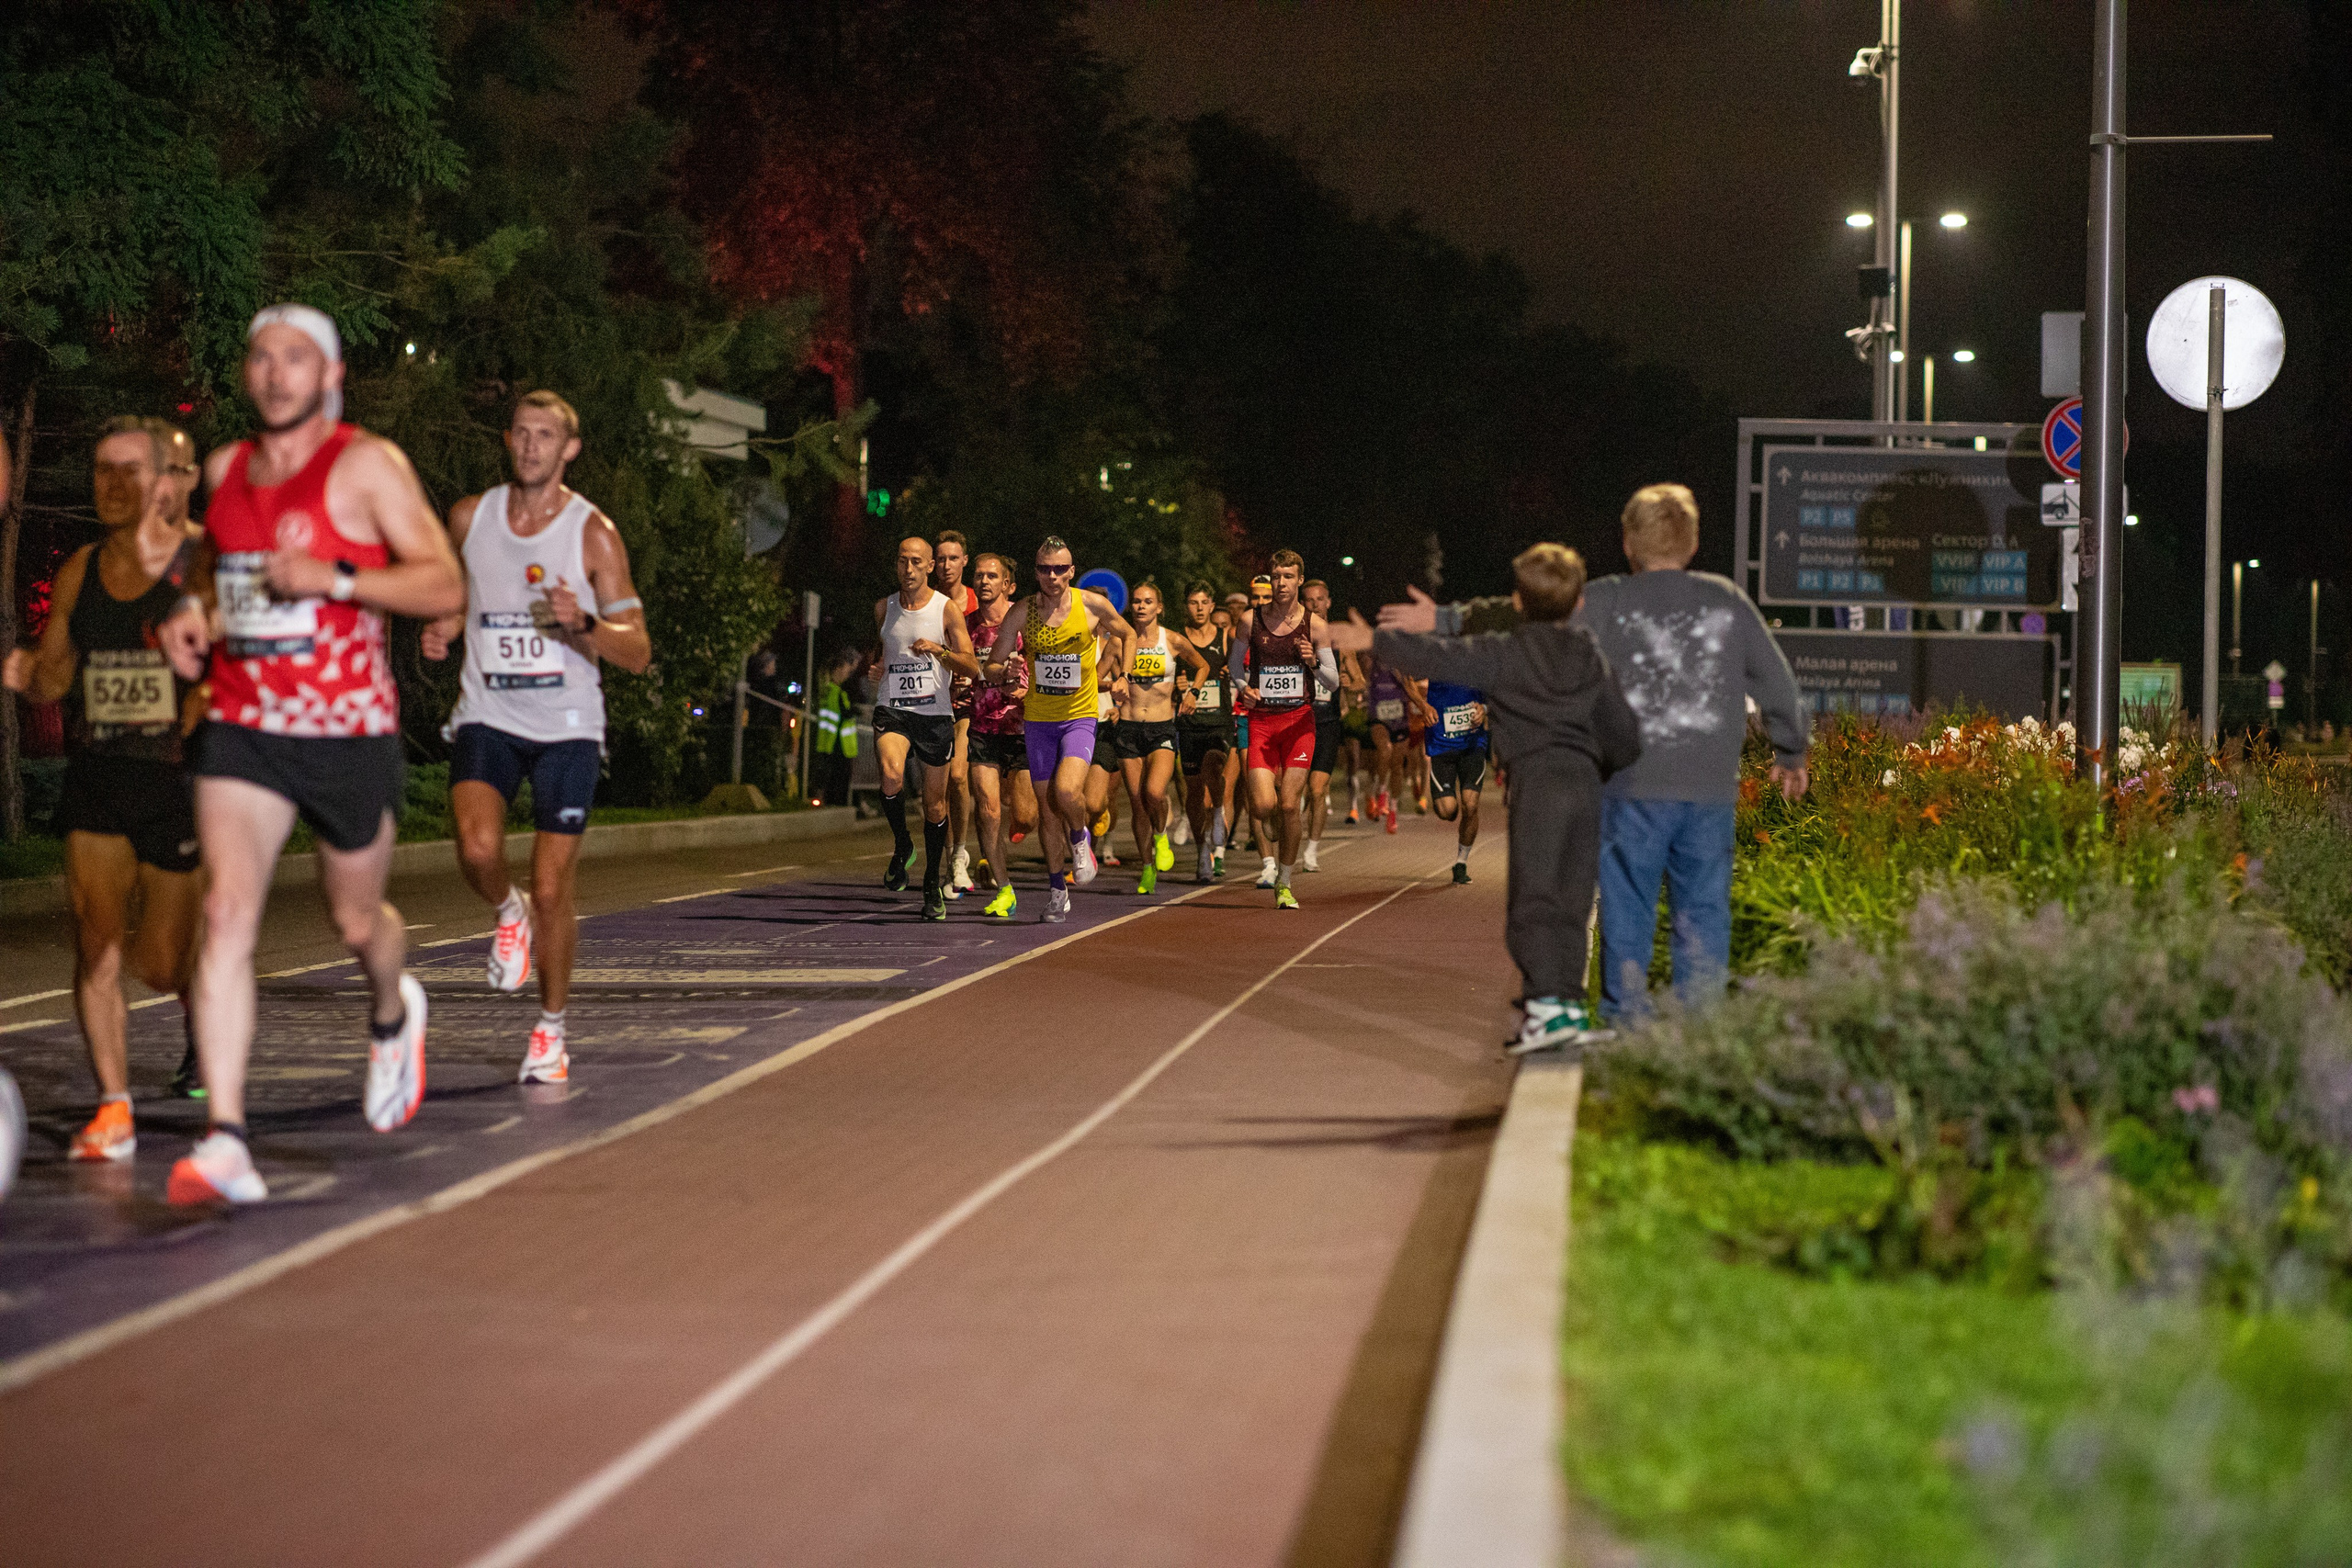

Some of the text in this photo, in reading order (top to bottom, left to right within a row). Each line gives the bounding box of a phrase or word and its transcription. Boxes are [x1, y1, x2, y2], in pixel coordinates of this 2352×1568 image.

[1984, 555, 2025, 569] VIP A
[1983, 578, 2009, 592] VIP
[499, 635, 544, 660] 510
[1794, 656, 1899, 674] Малая арена
[1045, 666, 1071, 680] 265
[93, 676, 161, 705] 5265
[899, 675, 923, 691] 201
[1265, 677, 1296, 690] 4581
